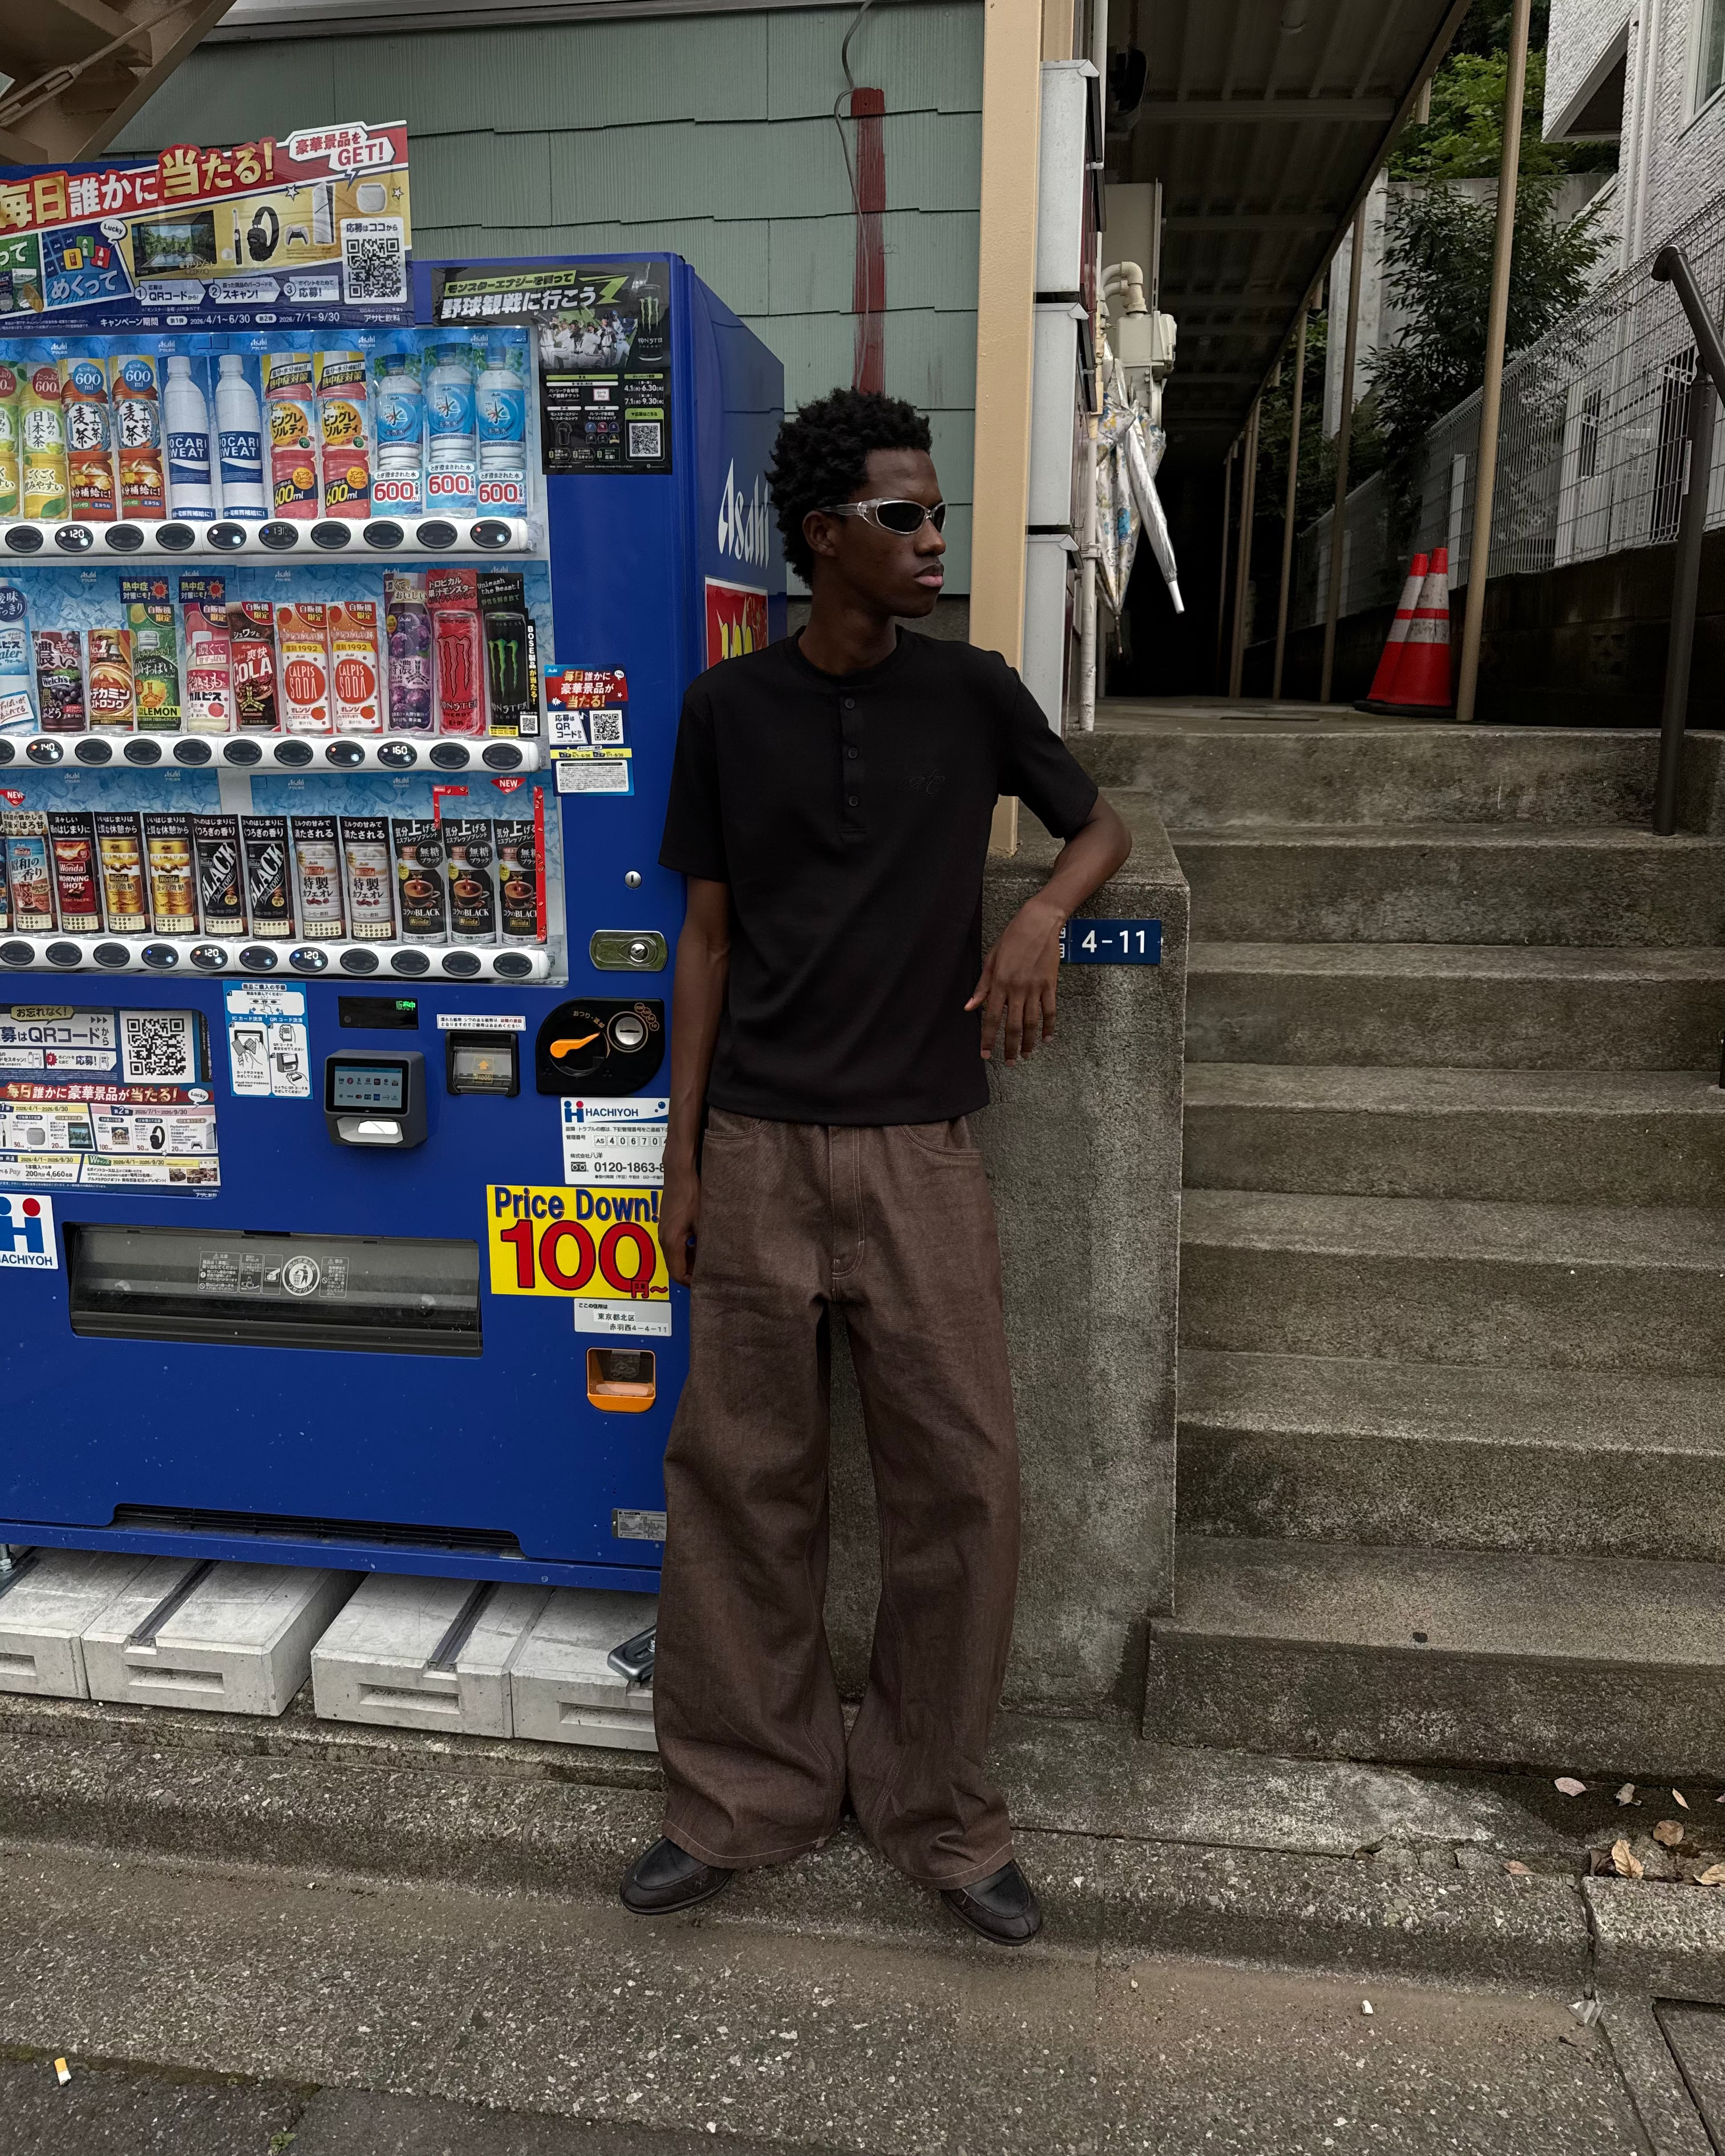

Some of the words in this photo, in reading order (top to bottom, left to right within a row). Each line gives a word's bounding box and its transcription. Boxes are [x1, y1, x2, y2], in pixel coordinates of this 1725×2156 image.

[295, 131, 361, 155] 豪華景品を
[338, 141, 384, 166] GET!
[104, 224, 123, 234] Lucky
[346, 223, 398, 233] 応募はココから
[51, 270, 118, 299] めくって
[223, 290, 258, 299] スキャン!
[299, 287, 322, 298] 応募!
[440, 287, 597, 319] 野球観戦に行こう
[100, 317, 159, 326] キャンペーン期間
[75, 374, 101, 385] 600
[125, 371, 151, 382] 600
[47, 412, 55, 436] 旨みの
[90, 408, 103, 440] 十六茶
[123, 403, 143, 445] 麦茶
[139, 406, 152, 438] 十六茶
[272, 412, 302, 427] ピングレ
[324, 411, 357, 427] ピングレ
[32, 411, 46, 447] 日本茶
[73, 406, 93, 448] 麦茶
[273, 424, 304, 439] ソルティ
[326, 423, 358, 438] ソルティ
[28, 469, 54, 480] ごくごく
[718, 457, 769, 570] Asahi
[70, 529, 84, 538] 120
[123, 582, 148, 591] 熱中症
[181, 582, 205, 591] 熱中症
[429, 577, 461, 589] トロピカル
[477, 578, 505, 589] Unleash
[496, 580, 520, 592] Beast!
[395, 590, 427, 599] おいしい
[428, 586, 475, 598] 果汁モンスター
[481, 594, 520, 606] 野性を解き放て
[246, 603, 269, 611] 自販機
[210, 613, 226, 622] 限定
[357, 611, 372, 620] 限定
[233, 629, 260, 639] シュワッと
[35, 642, 77, 667] 濃い
[198, 643, 225, 655] 濃くて
[246, 646, 268, 662] 爽快
[233, 656, 273, 686] COLA
[289, 666, 315, 678] CALPIS
[339, 664, 365, 676] CALPIS
[390, 660, 411, 675] 特濃
[43, 676, 68, 684] Welch's
[564, 671, 610, 682] 毎日誰かに
[290, 677, 317, 699] SODA
[340, 676, 366, 698] SODA
[561, 683, 614, 695] 豪華景品が
[189, 692, 223, 702] カルピス
[568, 695, 605, 708] 当たる!
[42, 708, 61, 719] ぶどう
[392, 746, 408, 755] 160
[147, 826, 189, 835] 上質な休憩から
[195, 826, 235, 837] くつろぎの香り
[244, 828, 284, 838] くつろぎの香り
[344, 830, 385, 839] 満たされる
[445, 820, 487, 837] 気分上げる
[396, 833, 438, 844] エスプレッソブレンド
[446, 833, 488, 844] エスプレッソブレンド
[420, 847, 440, 857] 無糖
[469, 847, 489, 857] 無糖
[12, 858, 39, 872] 昭和の
[59, 863, 84, 872] Wonda
[21, 868, 42, 881] 香り
[201, 842, 237, 906] BLACK
[303, 877, 329, 890] 特製
[353, 878, 378, 891] 特製
[1082, 930, 1145, 953] 4-11
[204, 949, 219, 958] 120
[304, 951, 319, 960] 120
[396, 1000, 416, 1011] 販売中
[17, 1007, 67, 1017] お忘れなく!
[0, 1027, 109, 1045] 募はQRコードから
[76, 1056, 97, 1066] 応募!
[7, 1084, 177, 1102] 毎日誰かに豪華景品が当たる!
[586, 1108, 639, 1117] HACHIYOH
[494, 1186, 565, 1219] Price
[575, 1188, 659, 1223] Down!
[288, 1283, 313, 1293] リサイクル
[598, 1313, 635, 1322] 東京都北区
